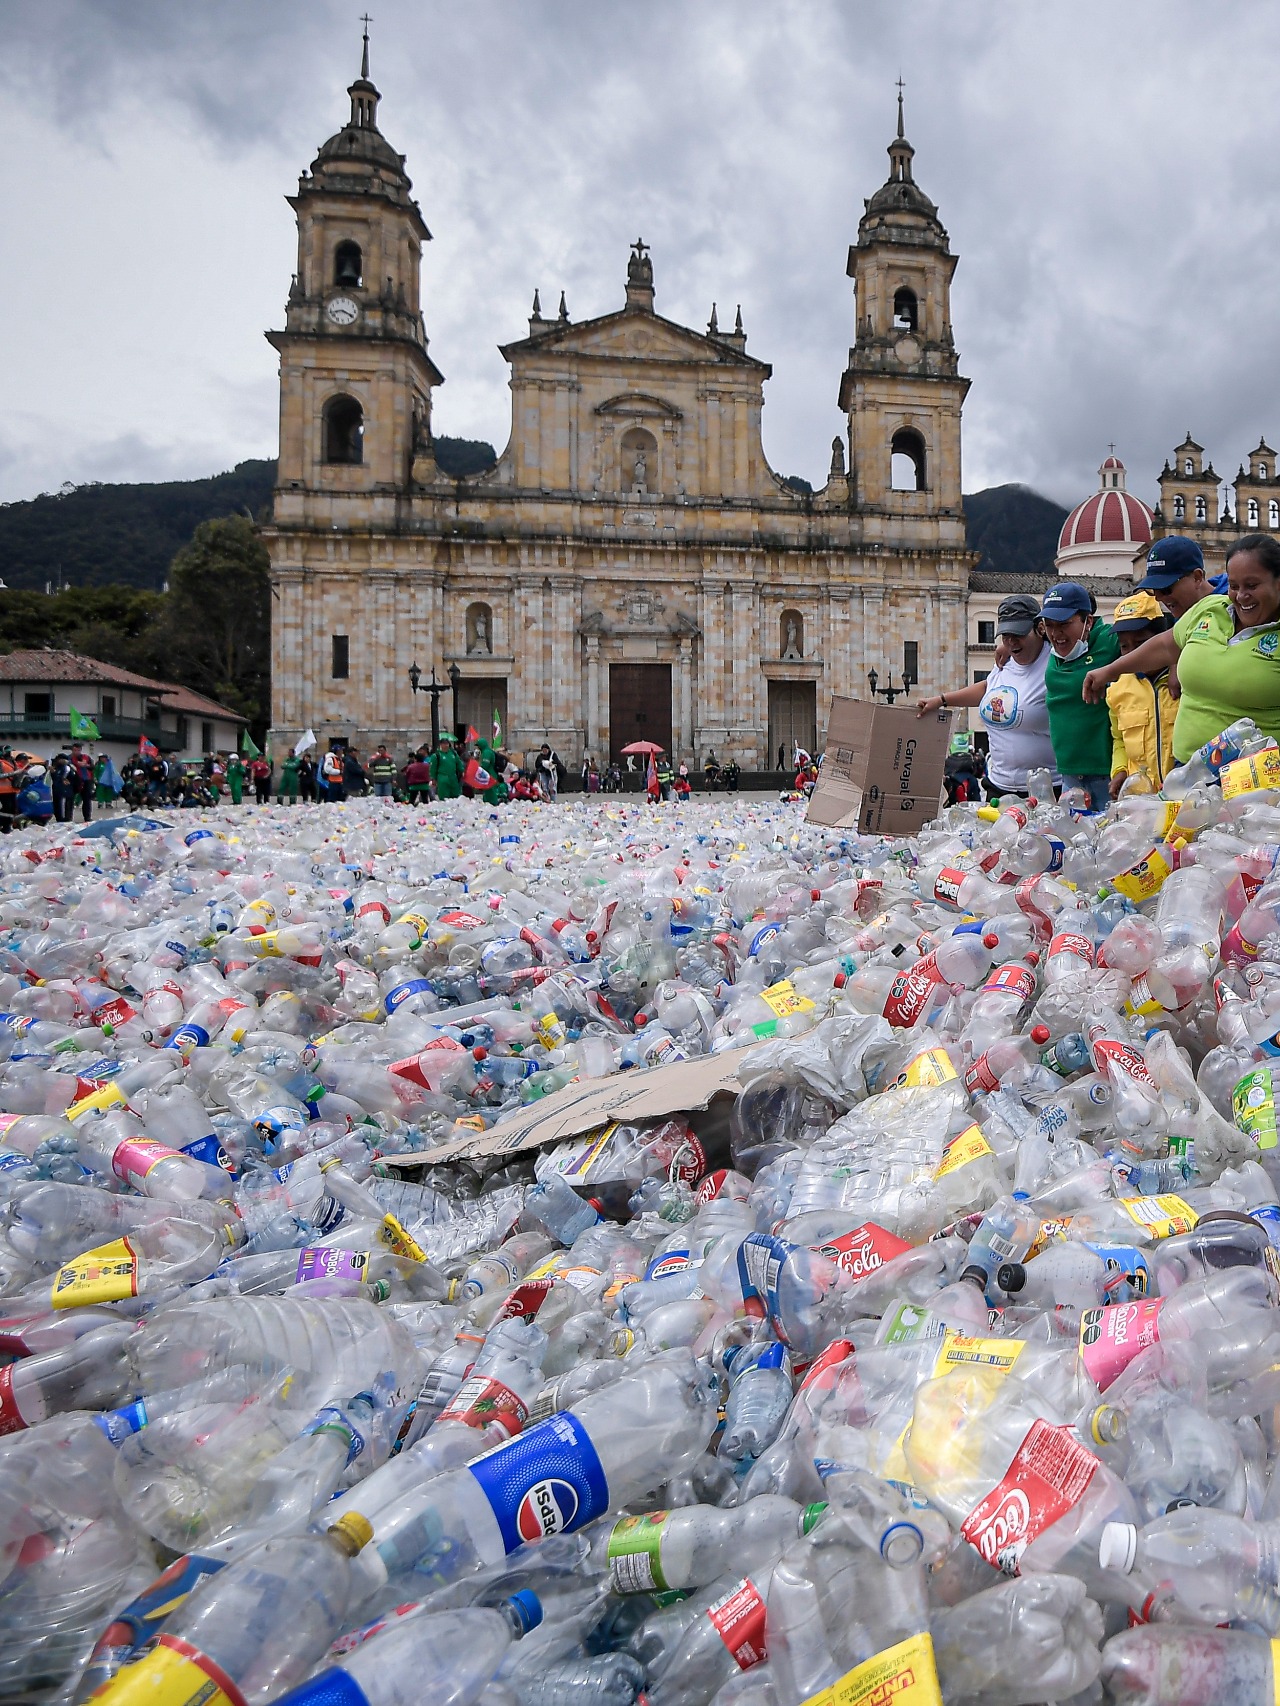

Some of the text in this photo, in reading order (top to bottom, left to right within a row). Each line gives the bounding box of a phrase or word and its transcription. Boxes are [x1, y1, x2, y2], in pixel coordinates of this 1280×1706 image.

[892, 737, 903, 769] EMPAQUES
[898, 738, 917, 796] Carvajal
[935, 879, 960, 900] BIG
[898, 970, 931, 1021] Coca-Cola
[655, 1262, 694, 1274] PEPSI
[534, 1485, 557, 1536] PEPSI
[964, 1502, 989, 1529] SABOR
[722, 1598, 760, 1633] RECICLAME
[849, 1669, 898, 1703] CON LA NUESTRA
